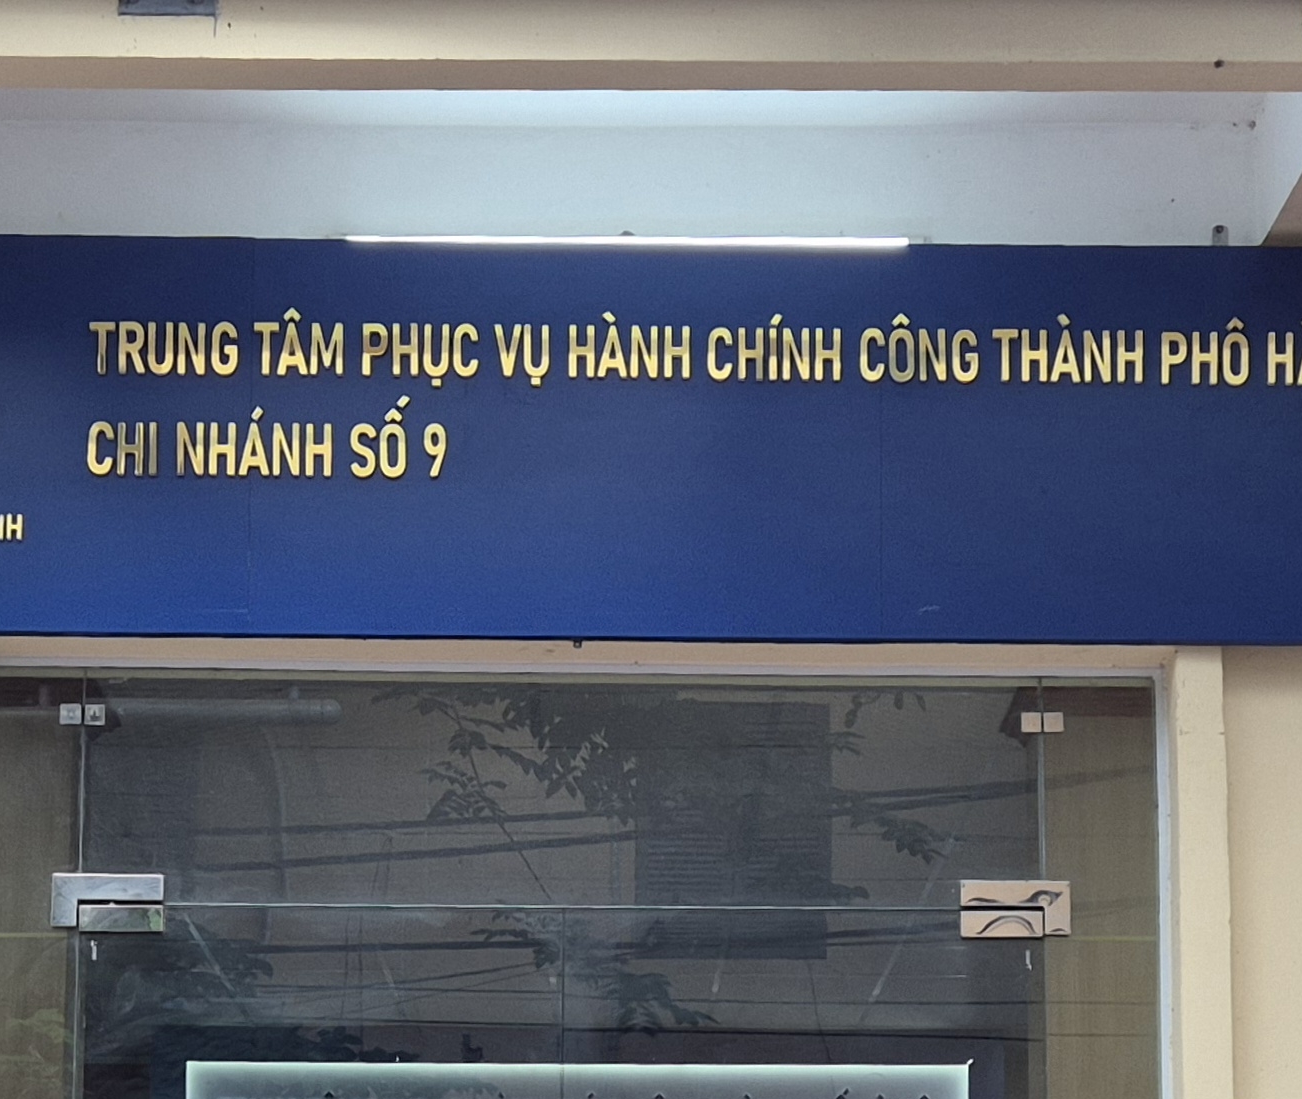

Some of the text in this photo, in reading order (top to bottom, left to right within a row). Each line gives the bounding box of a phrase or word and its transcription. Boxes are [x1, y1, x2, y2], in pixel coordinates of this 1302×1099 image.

[89, 321, 240, 378] TRUNG
[253, 309, 345, 377] TÂM
[360, 322, 480, 389] PHỤC
[493, 325, 551, 388] VỤ
[567, 312, 693, 381] HÀNH
[706, 314, 843, 385] CHÍNH
[858, 314, 981, 385] CÔNG
[992, 315, 1145, 385] THÀNH
[87, 396, 448, 480] CHI NHÁNH SỐ 9
